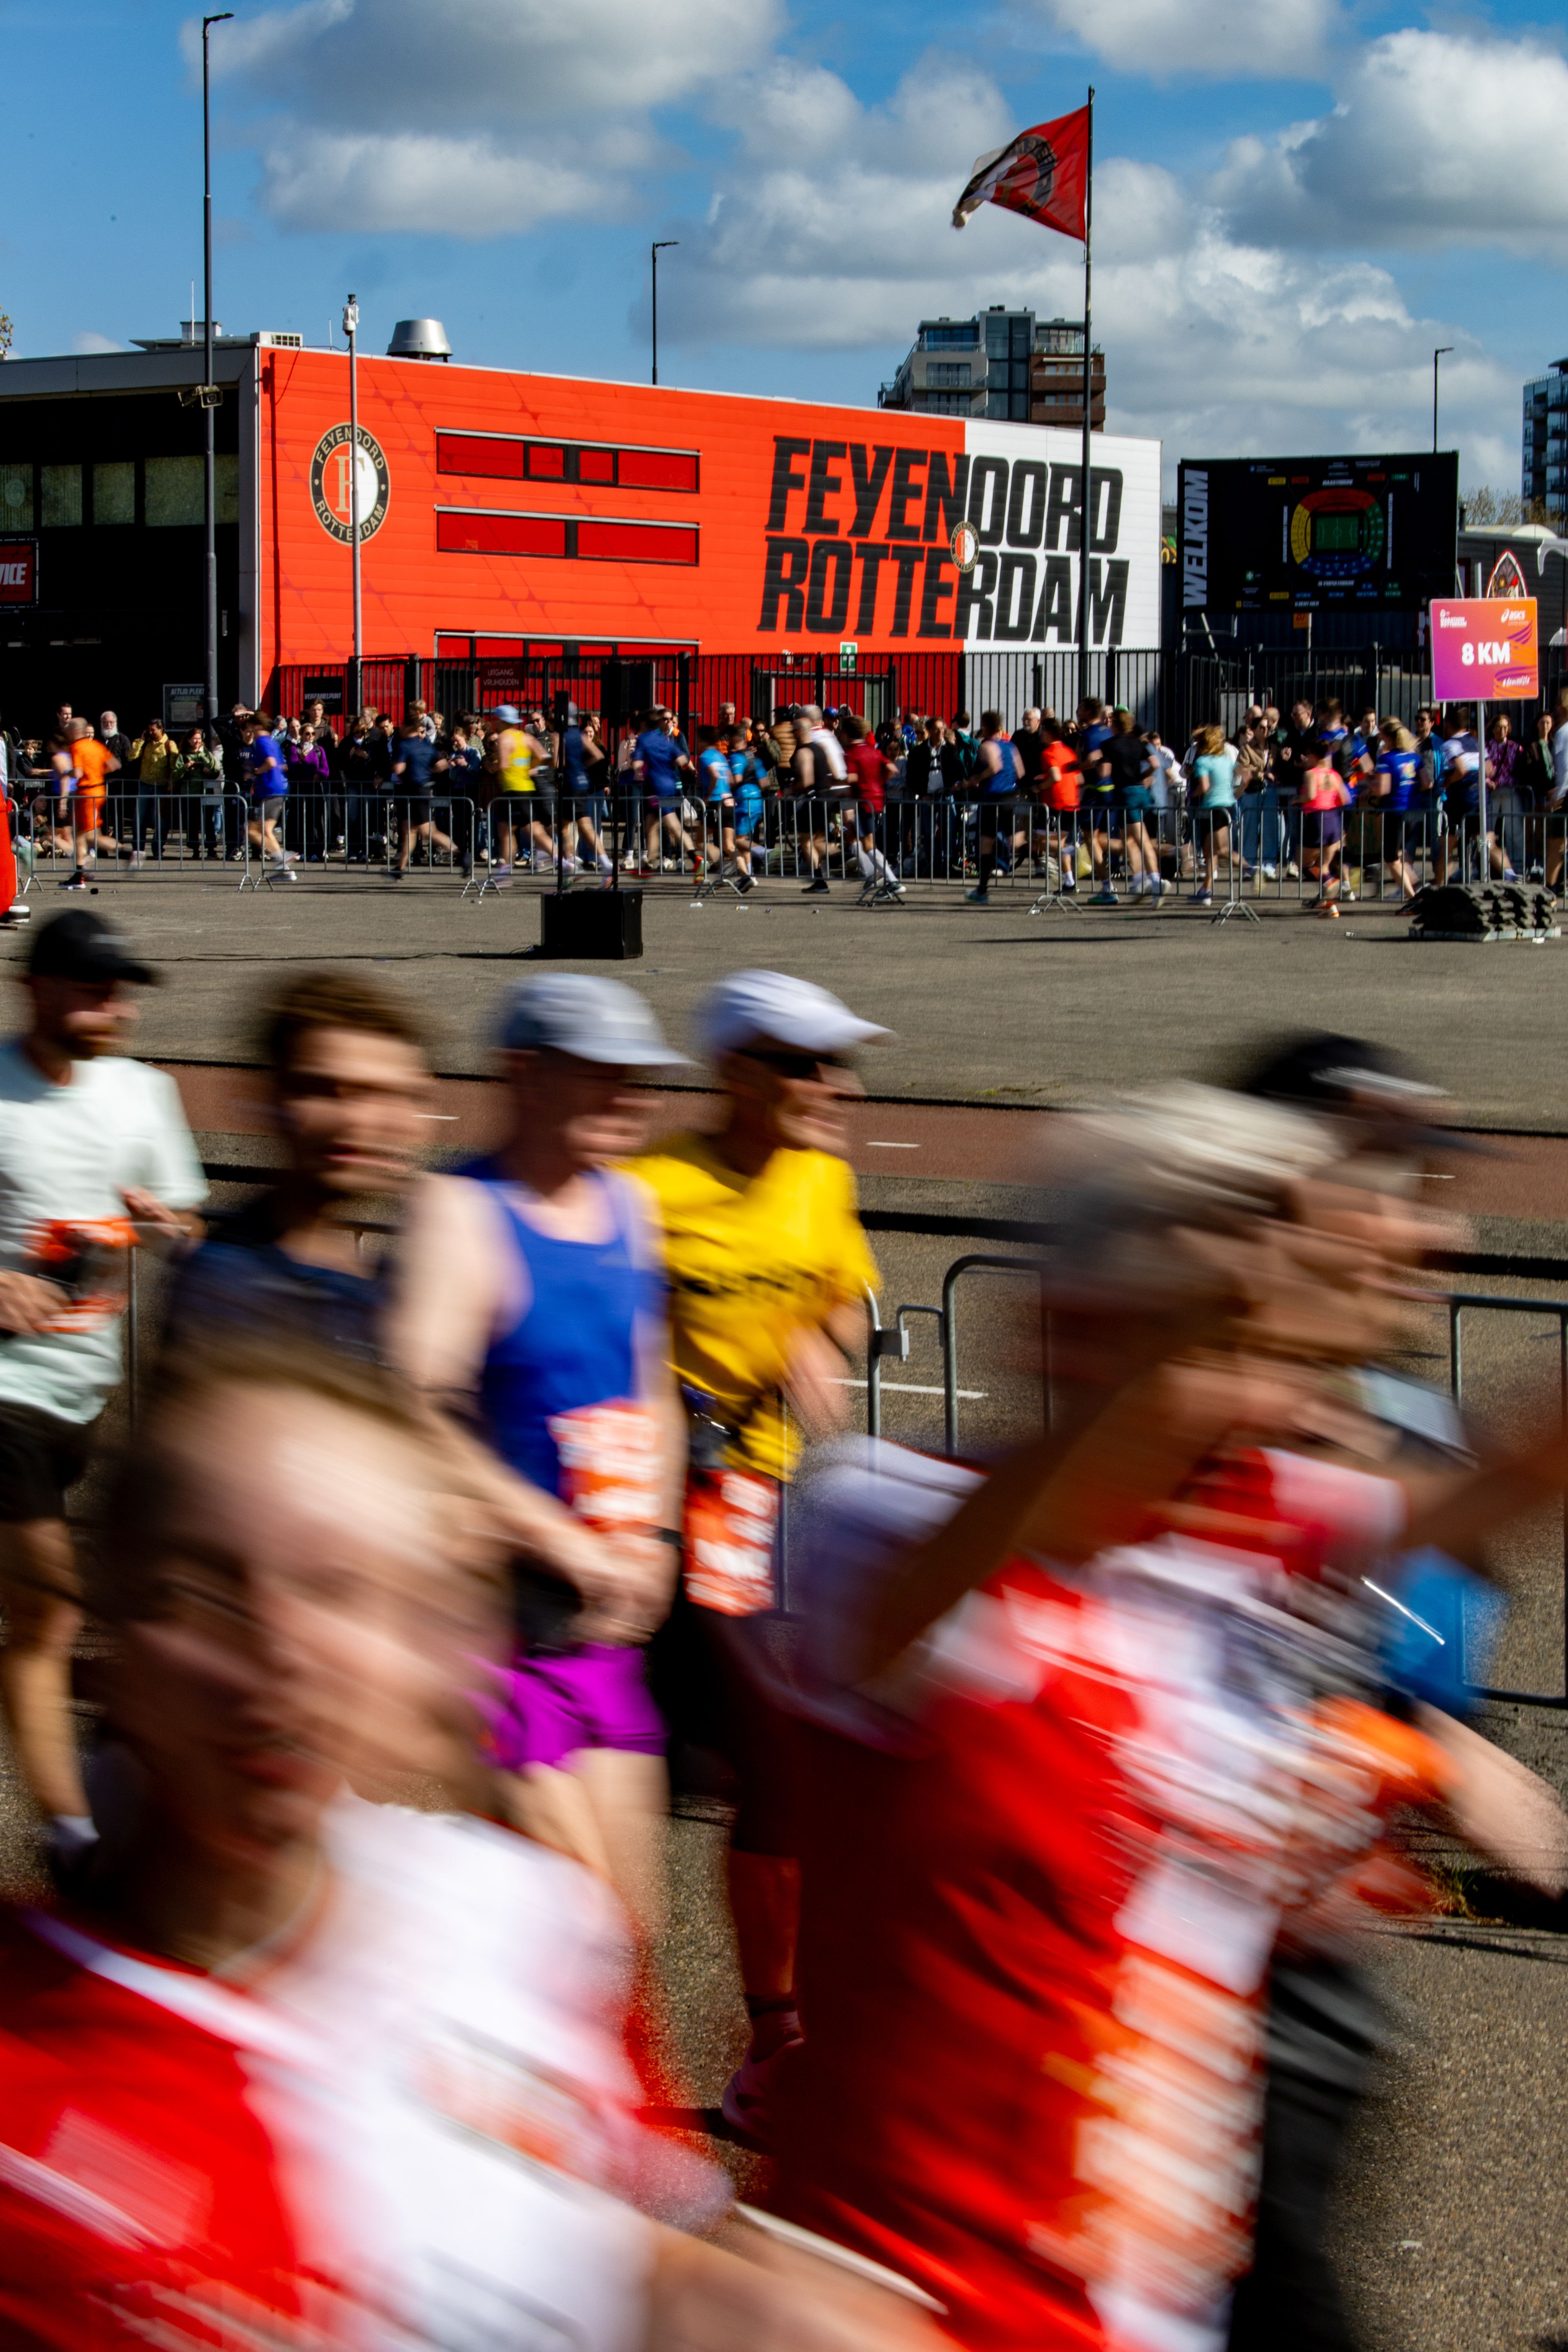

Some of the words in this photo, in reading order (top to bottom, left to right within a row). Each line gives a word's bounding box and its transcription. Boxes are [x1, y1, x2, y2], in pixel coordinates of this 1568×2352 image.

[316, 427, 384, 470] FEYENOORD
[765, 435, 1123, 554] FEYENOORD
[756, 535, 1129, 646] ROTTERDAM
[1183, 469, 1208, 608] WELKOM
[1462, 642, 1474, 666] 8
[1478, 641, 1510, 665] KM
